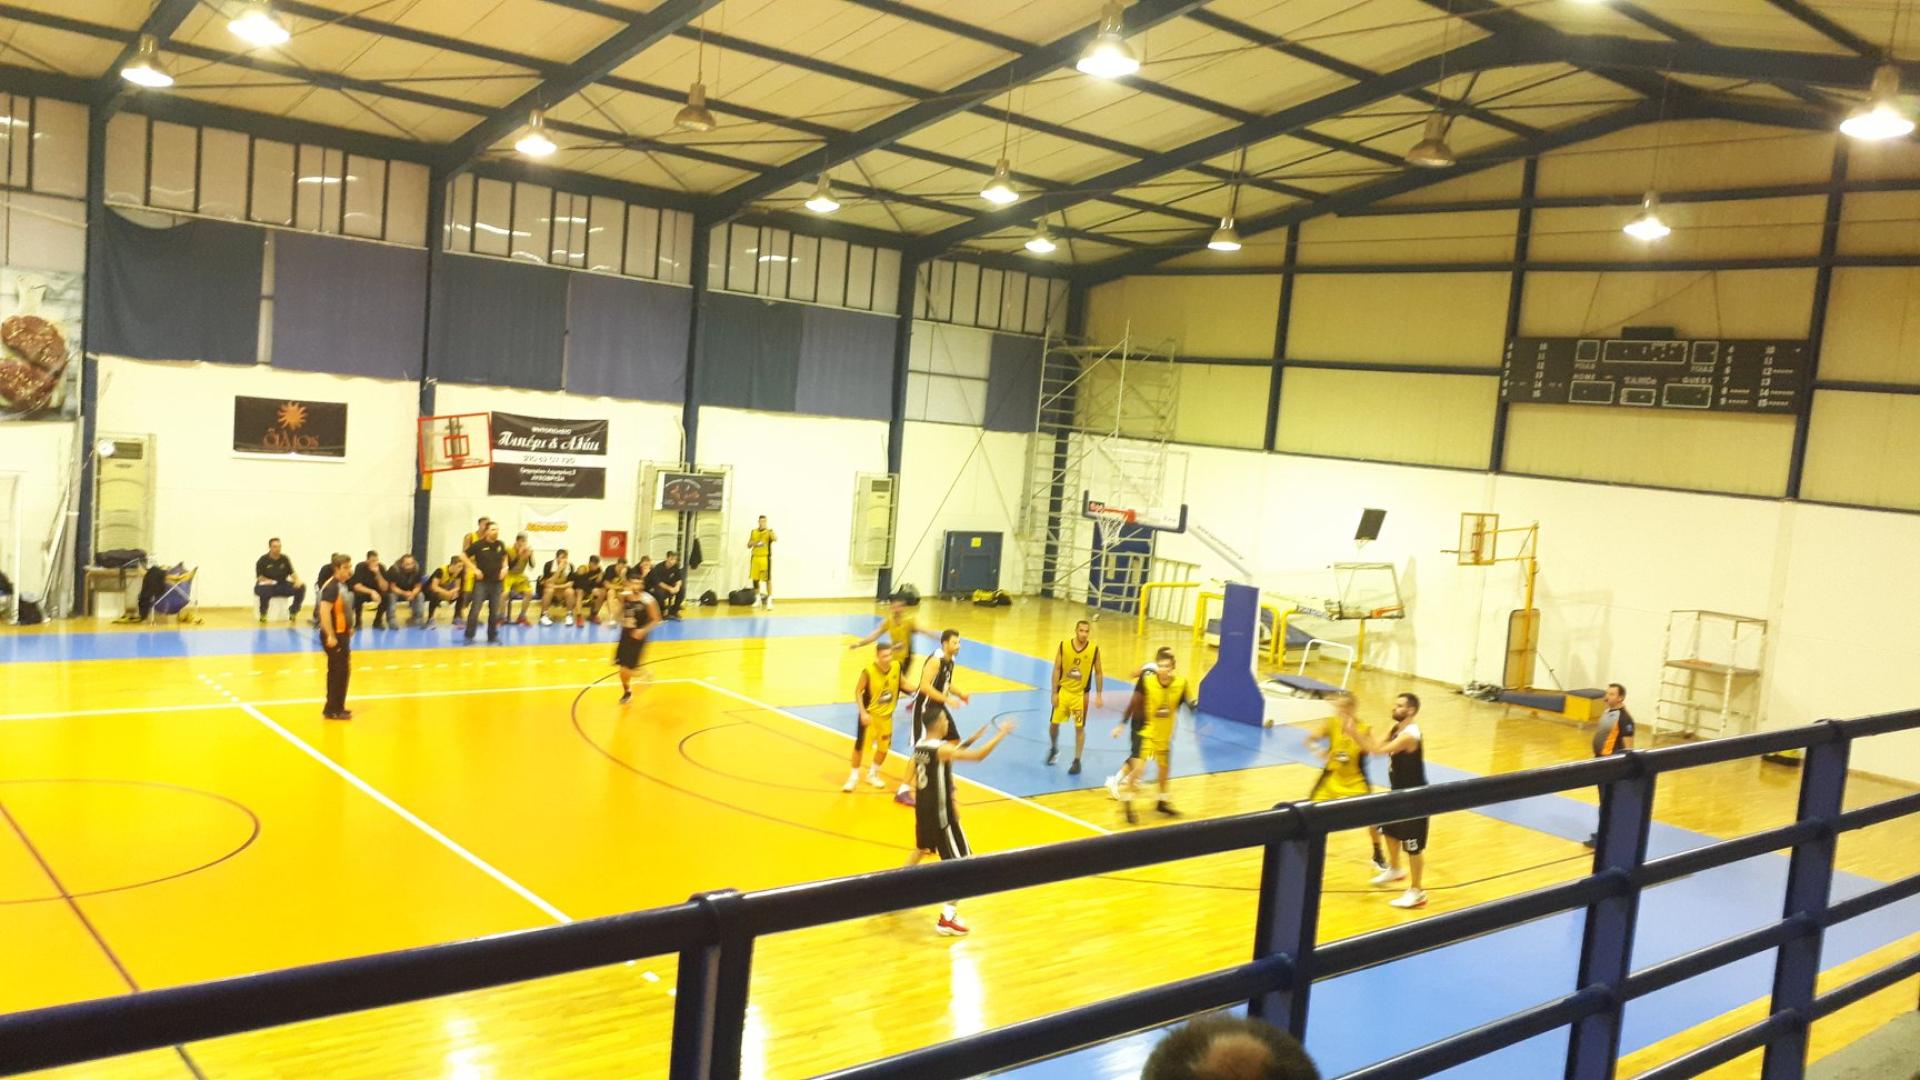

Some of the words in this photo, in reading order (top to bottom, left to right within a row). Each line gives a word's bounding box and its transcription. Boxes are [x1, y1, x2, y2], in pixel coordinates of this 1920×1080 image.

[1762, 367, 1773, 376] 12
[1761, 378, 1771, 386] 13
[1760, 388, 1770, 396] 14
[548, 437, 558, 450] &
[917, 763, 928, 790] 8
